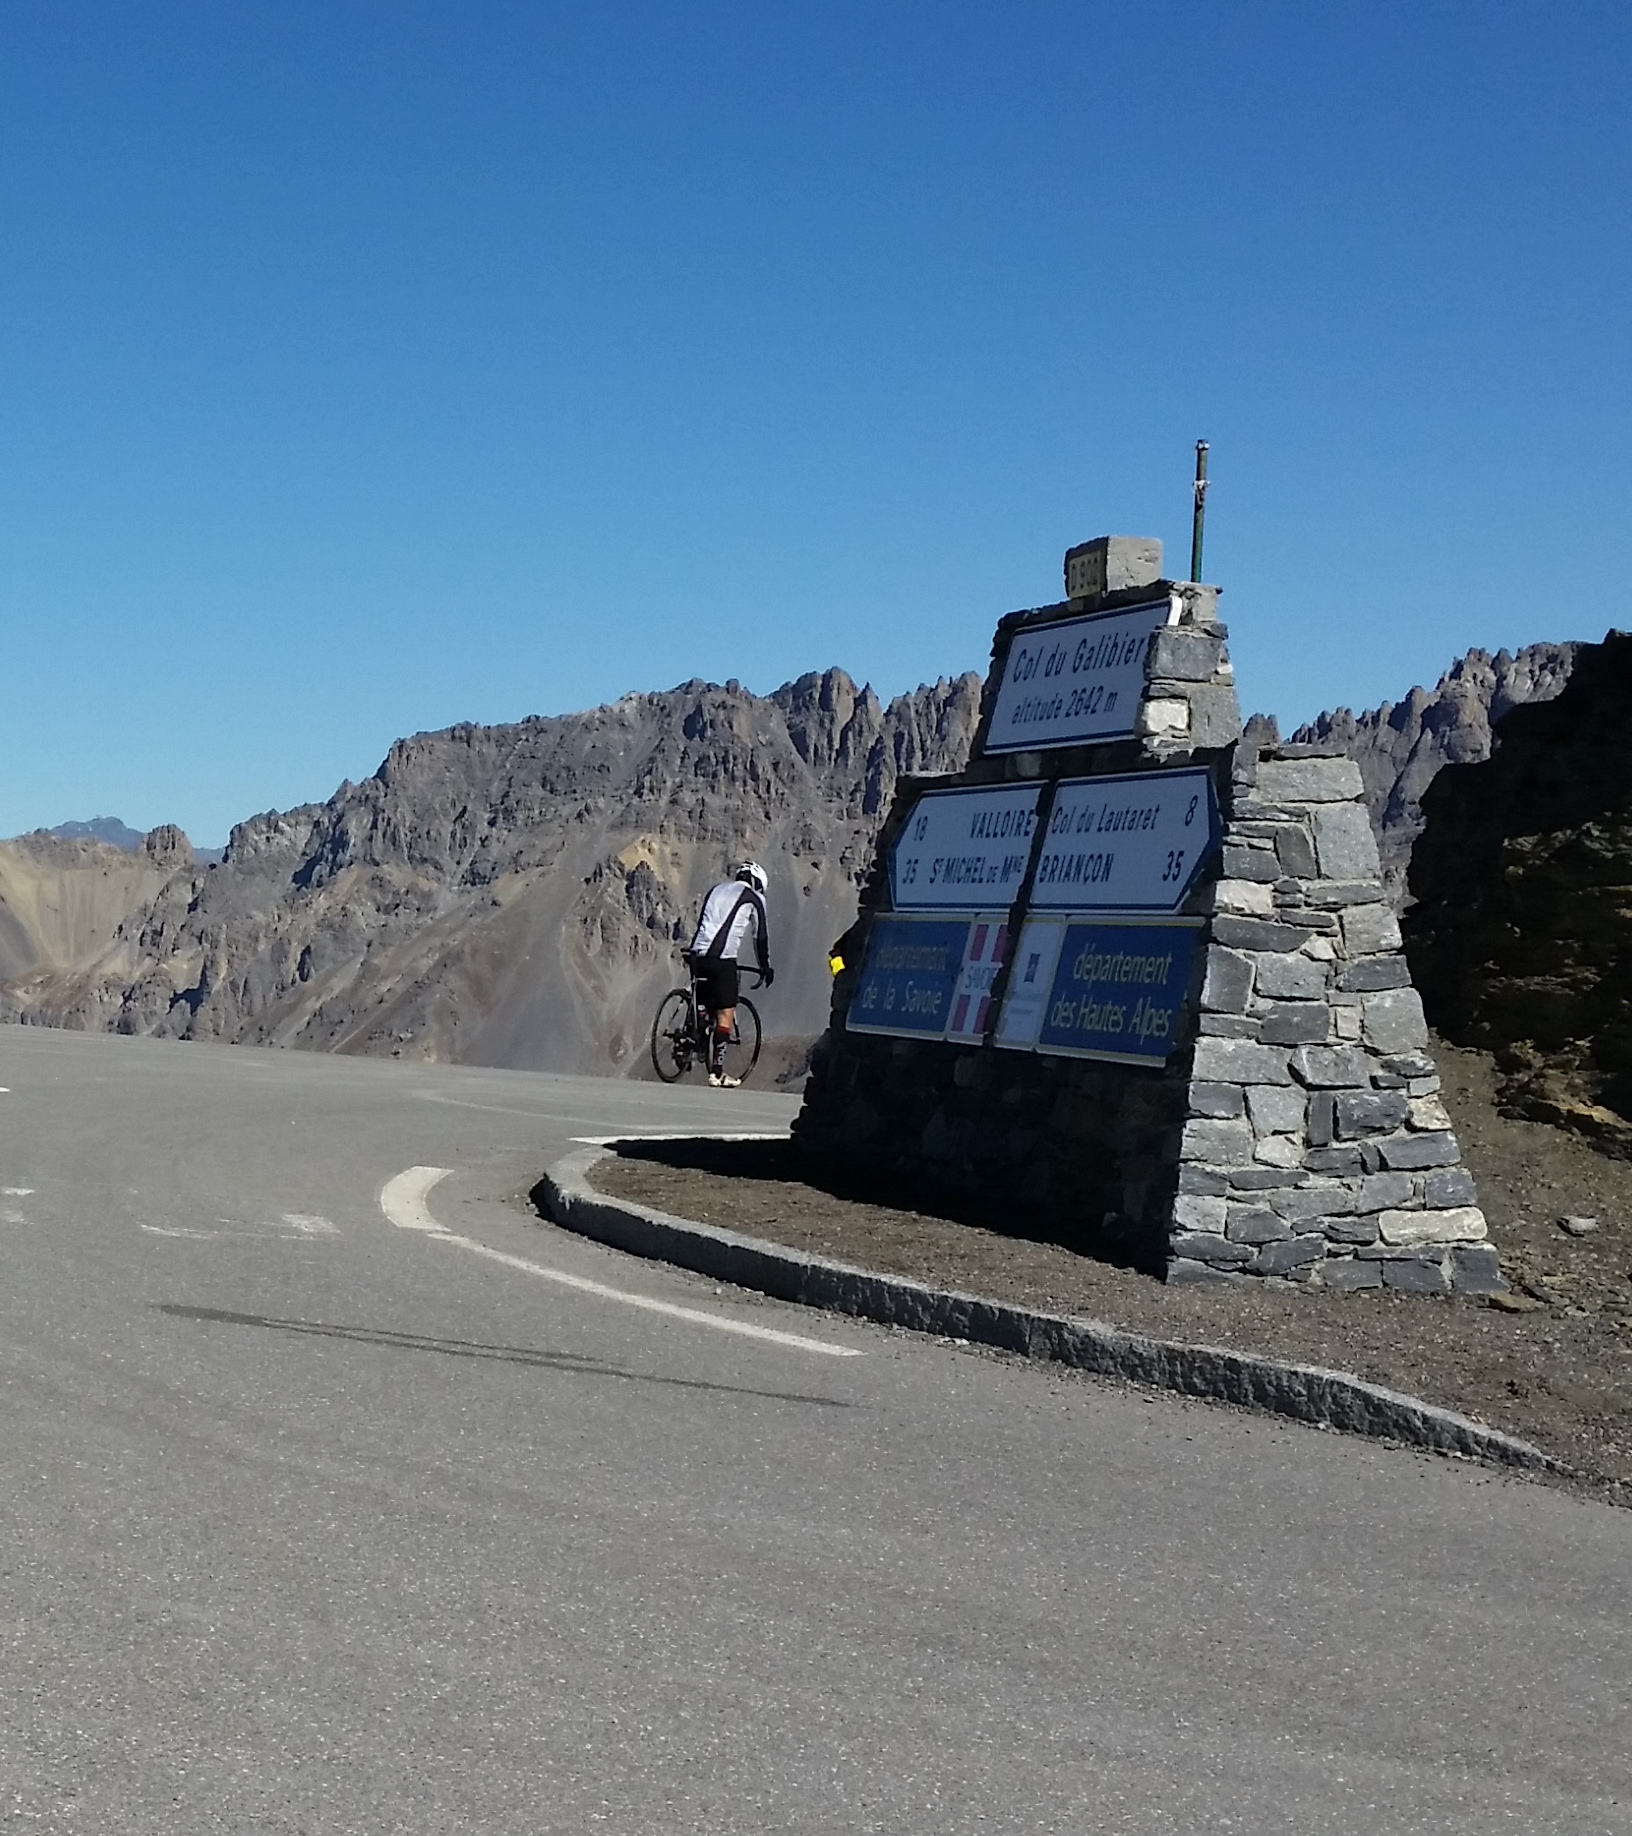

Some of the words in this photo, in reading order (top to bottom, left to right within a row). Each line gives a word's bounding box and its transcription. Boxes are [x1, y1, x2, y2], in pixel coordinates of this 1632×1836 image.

[1013, 645, 1045, 682] Col
[1044, 643, 1068, 678] du
[1072, 632, 1146, 674] Galibier
[1011, 692, 1064, 724] altitude
[1065, 685, 1104, 718] 2642
[1104, 691, 1118, 713] m
[914, 815, 929, 842] 18
[970, 808, 1035, 839] VALLOIRE
[1051, 806, 1077, 834] Col
[1076, 804, 1095, 833] du
[1096, 803, 1160, 833] Lautaret
[1184, 794, 1199, 827] 8
[902, 858, 919, 884] 35
[942, 856, 986, 884] MICHEL
[1039, 852, 1115, 885] BRIANÇON
[1162, 850, 1185, 882] 35
[1073, 943, 1173, 988] département
[862, 979, 878, 1009] de
[883, 978, 896, 1011] la
[900, 980, 943, 1014] Savoie
[1050, 992, 1076, 1029] des
[1076, 994, 1127, 1033] Hautes
[1127, 996, 1173, 1045] Alpes
